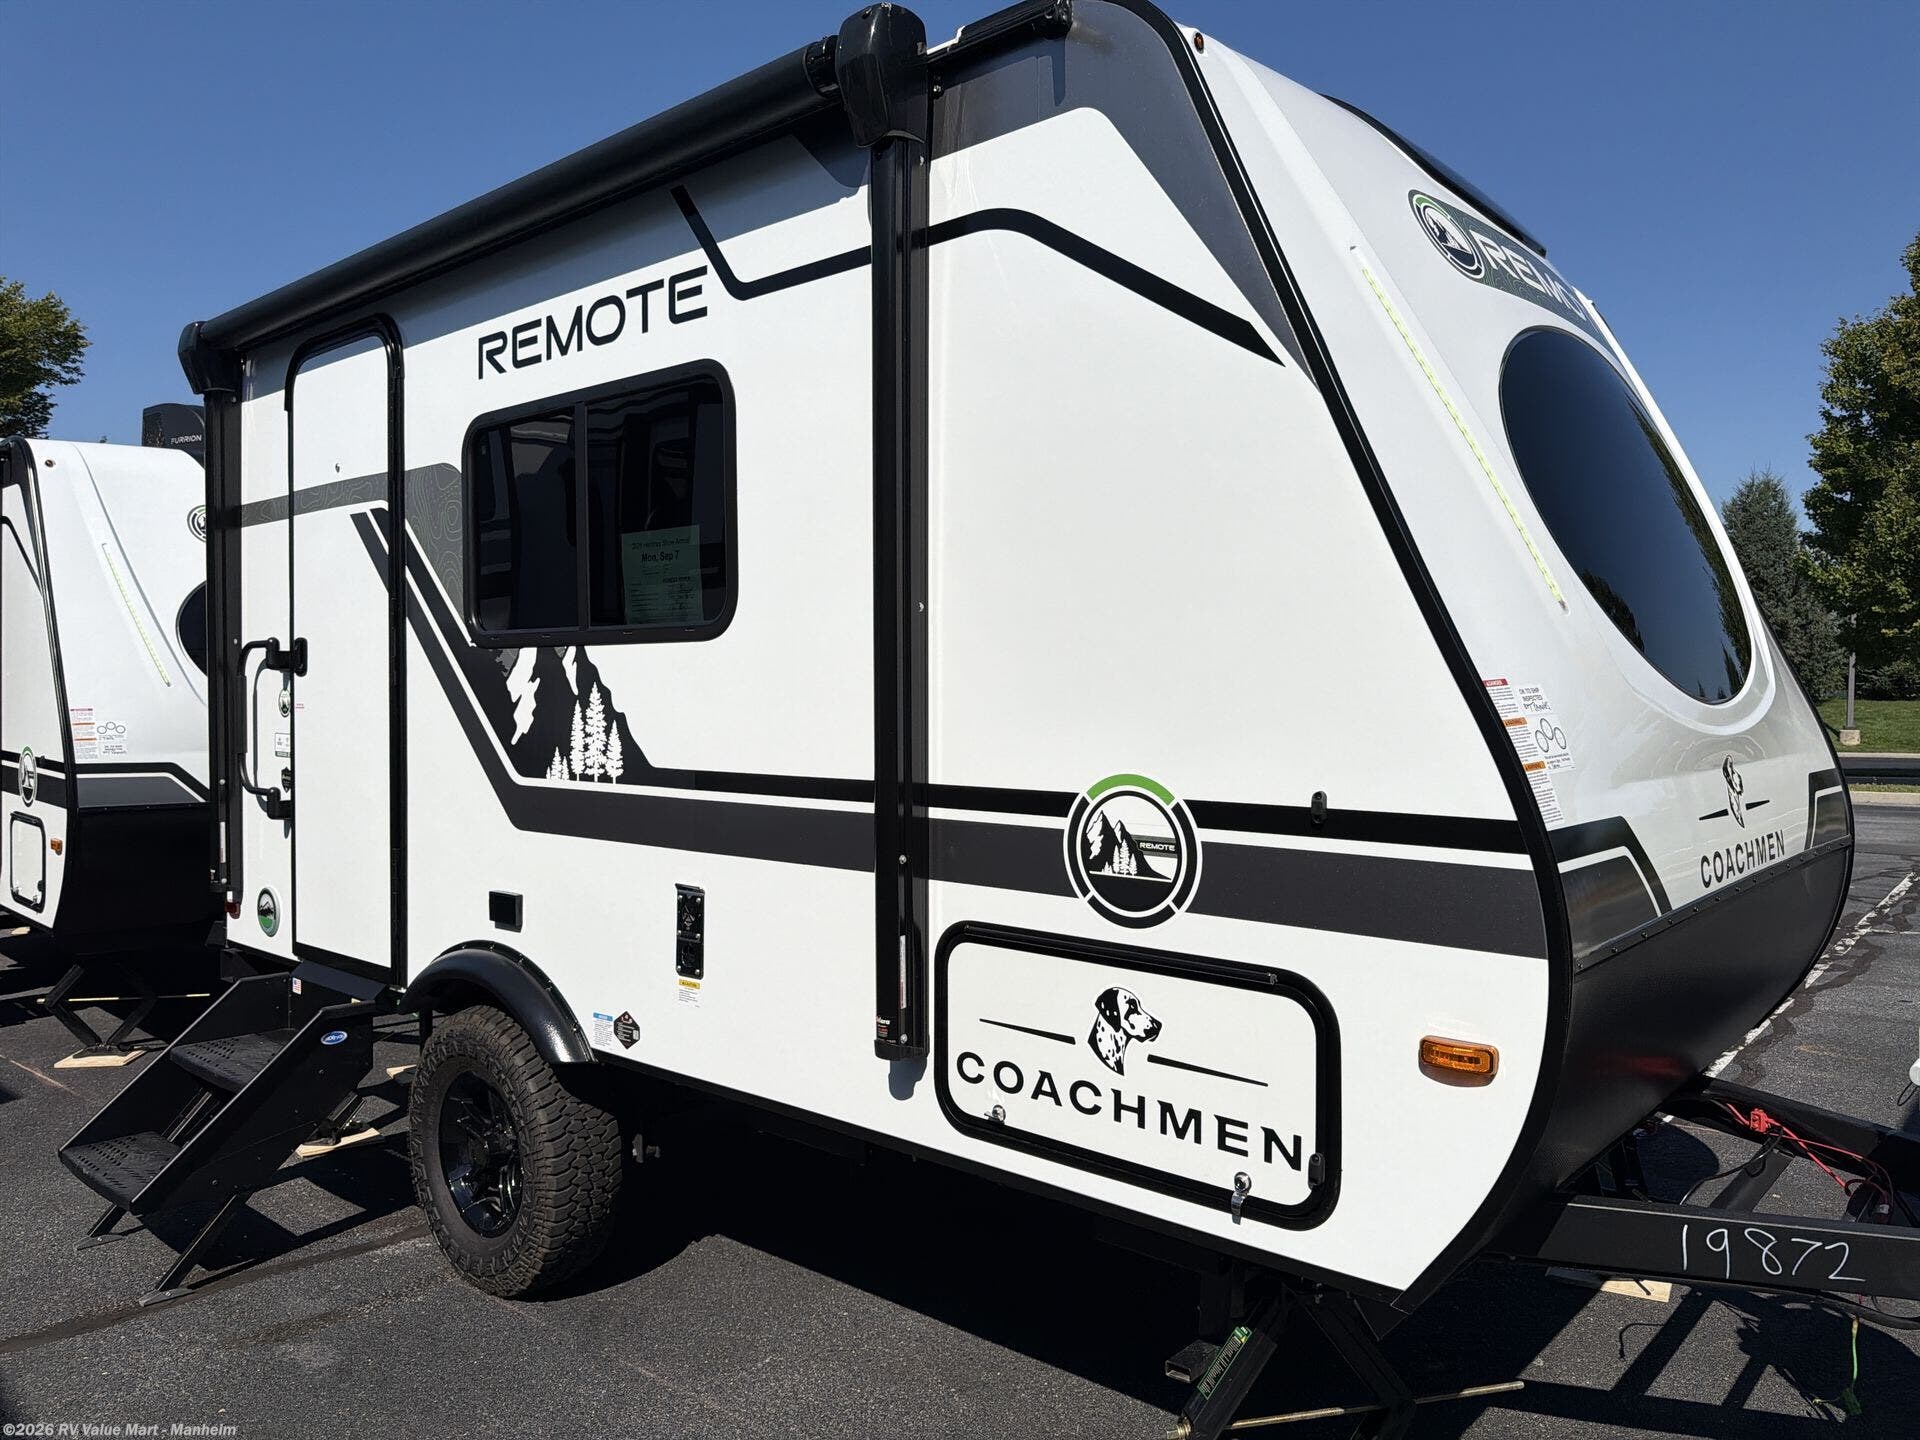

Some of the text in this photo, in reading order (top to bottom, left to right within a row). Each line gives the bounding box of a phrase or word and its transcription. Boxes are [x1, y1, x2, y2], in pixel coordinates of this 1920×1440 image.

[1469, 229, 1599, 333] REMO
[478, 265, 708, 380] REMOTE
[170, 434, 202, 445] FURRION
[1139, 842, 1176, 852] REMOTE
[1700, 829, 1785, 888] COACHMEN
[956, 1051, 1302, 1172] COACHMEN
[1682, 1224, 1867, 1282] 19872
